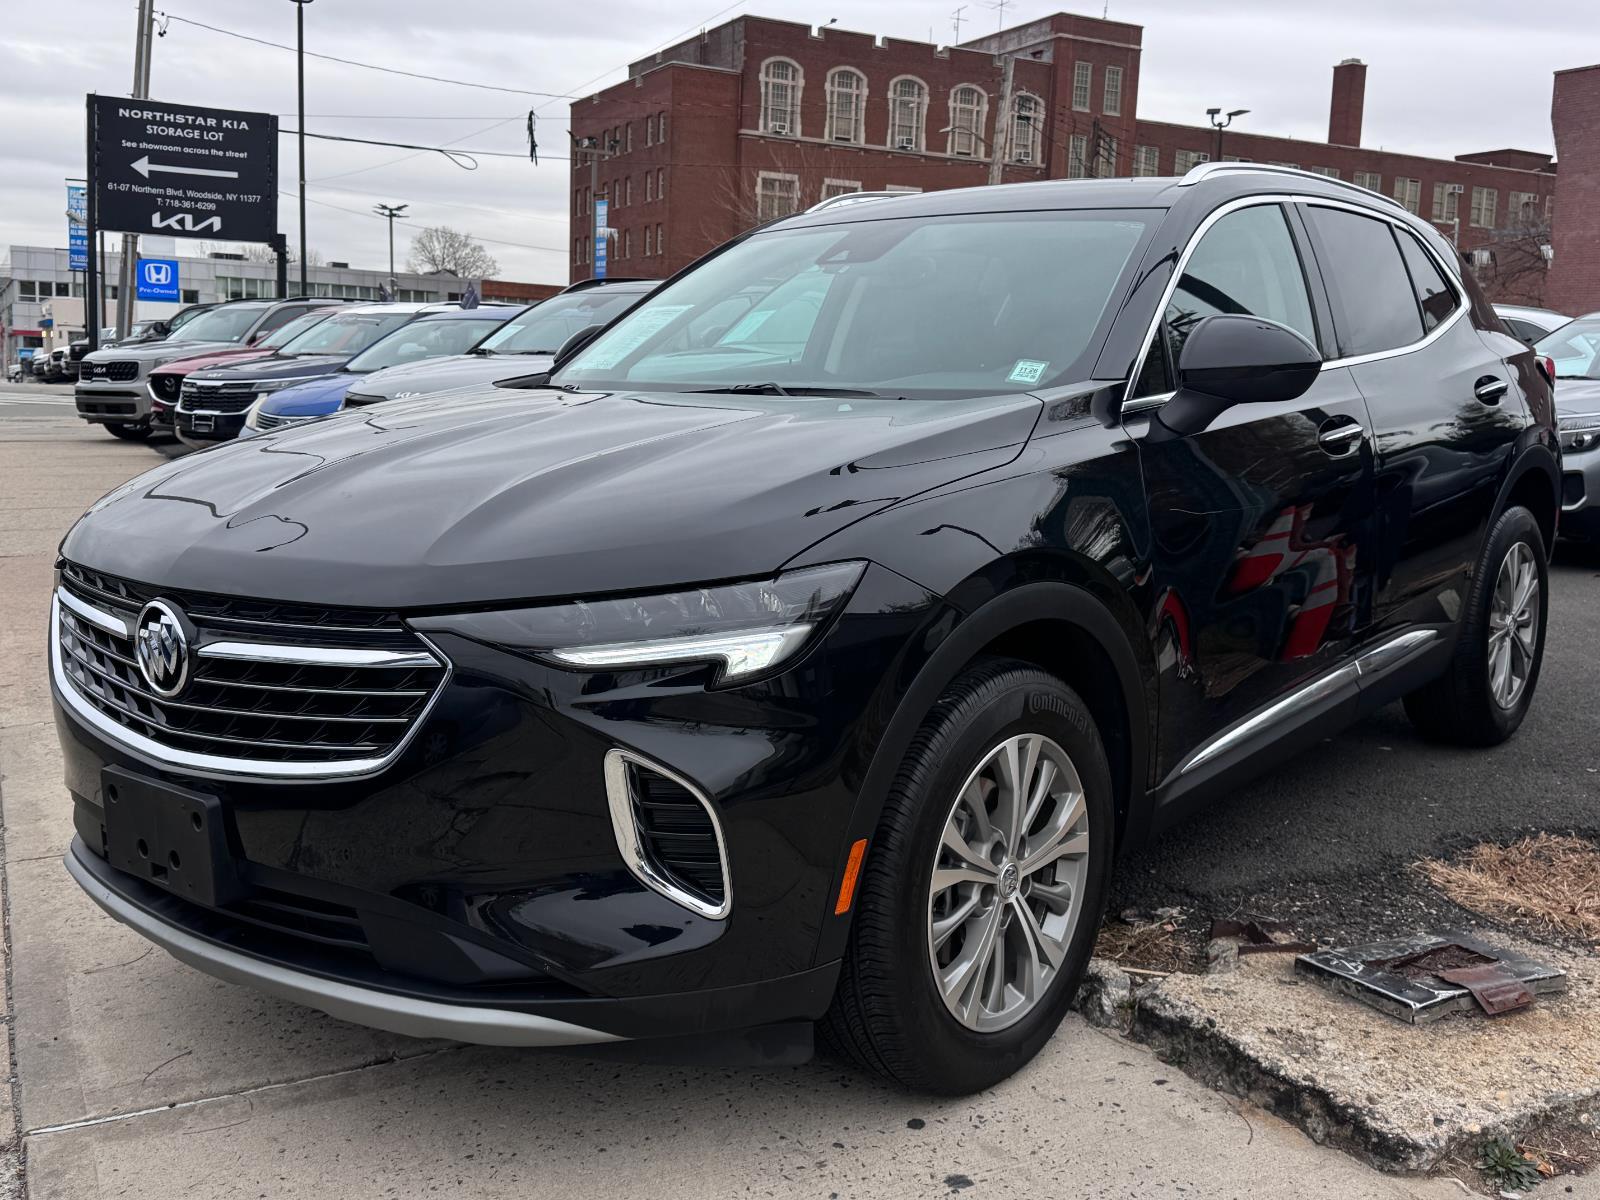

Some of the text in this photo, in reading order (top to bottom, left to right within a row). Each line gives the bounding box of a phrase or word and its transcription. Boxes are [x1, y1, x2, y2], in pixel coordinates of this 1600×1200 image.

[119, 108, 249, 130] NORTHSTAR KIA
[146, 125, 224, 141] STORAGE LOT
[121, 140, 137, 148] See
[139, 143, 181, 152] showroom
[107, 183, 130, 191] 61-07
[132, 185, 164, 194] Northern
[166, 188, 184, 197] Blvd,
[186, 190, 224, 200] Woodside,
[165, 199, 216, 210] 718-361-6299
[138, 287, 177, 295] Pre-Owned
[1028, 691, 1088, 734] Continental
